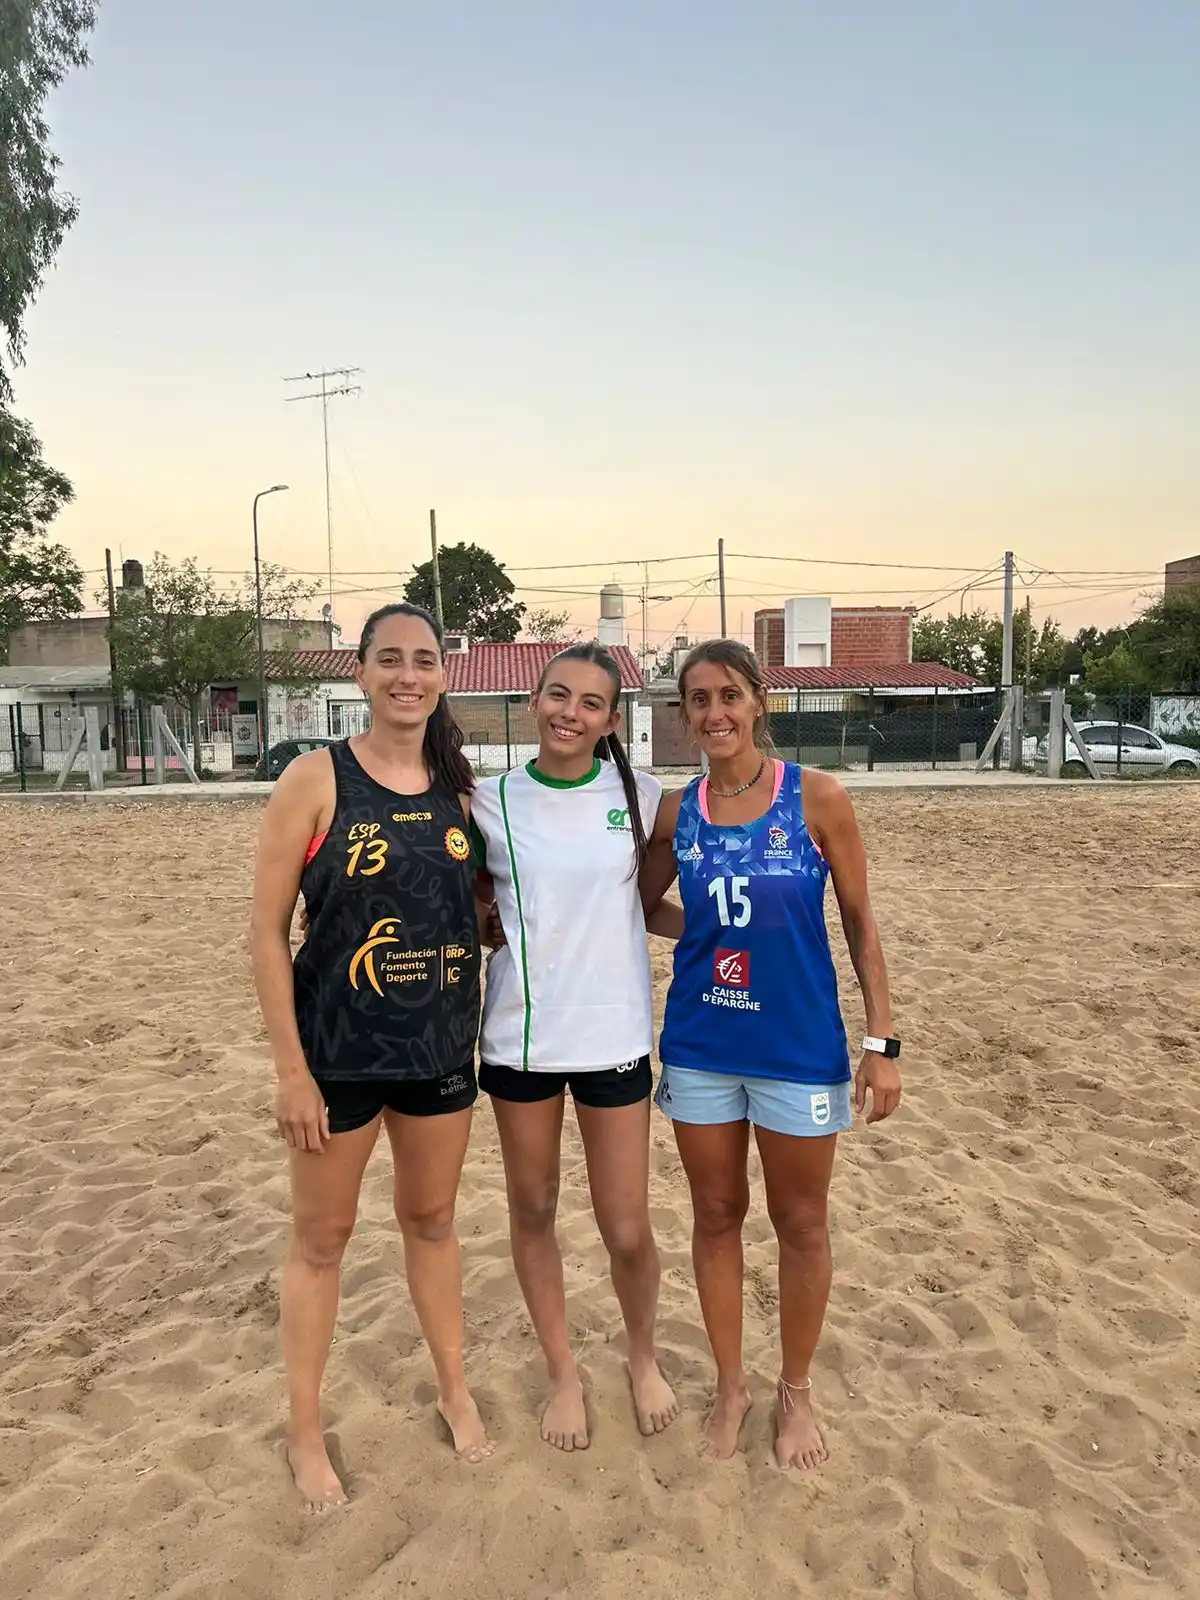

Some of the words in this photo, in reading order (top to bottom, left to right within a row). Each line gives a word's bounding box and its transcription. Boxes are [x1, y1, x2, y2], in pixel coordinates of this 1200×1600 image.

[348, 823, 381, 840] ESP
[346, 839, 389, 877] 13
[683, 851, 704, 861] adidas
[708, 876, 752, 928] 15
[386, 948, 437, 960] Fundación
[381, 961, 426, 971] Fomento
[386, 972, 428, 984] Deporte
[712, 986, 750, 1000] CAISSE
[702, 993, 761, 1011] D'EPARGNE
